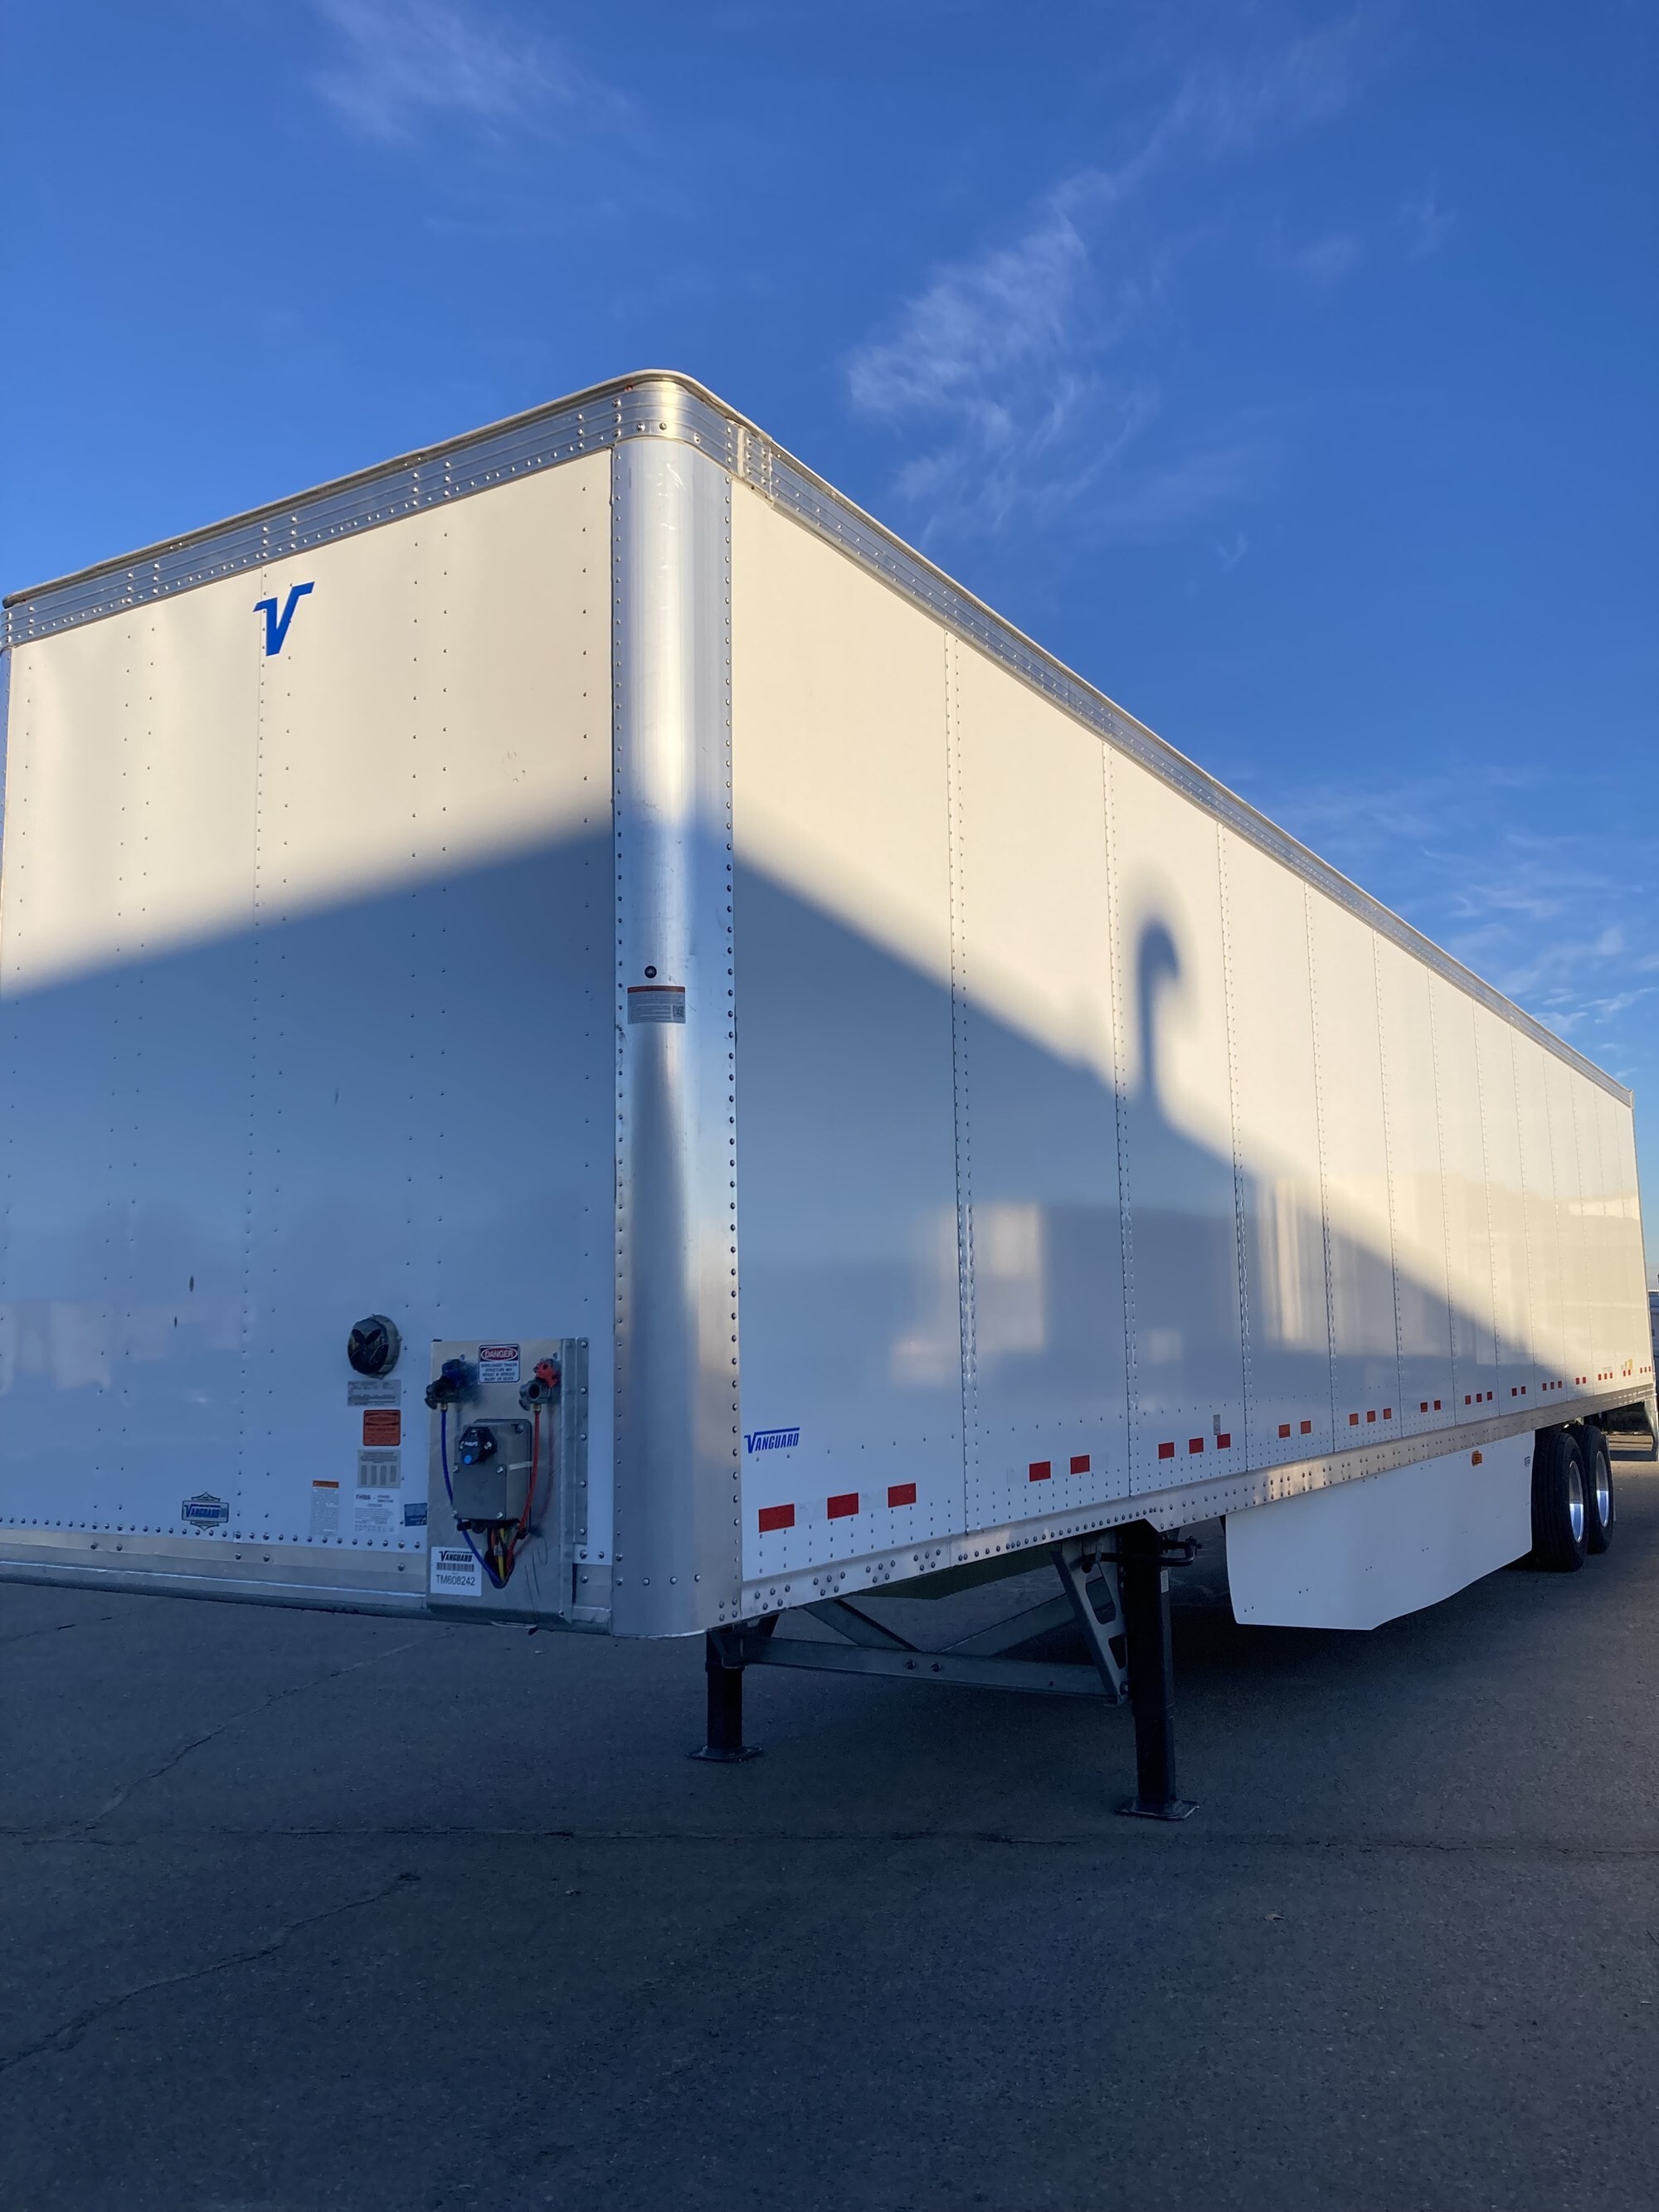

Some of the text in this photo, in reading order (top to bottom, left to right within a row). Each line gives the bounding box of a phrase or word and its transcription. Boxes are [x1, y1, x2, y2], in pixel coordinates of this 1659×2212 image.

[253, 581, 315, 657] V
[484, 1349, 513, 1359] DANGER
[743, 1427, 800, 1454] VANGUARD
[183, 1504, 221, 1519] VANGUARD
[439, 1550, 474, 1563] VANGUARD
[435, 1574, 475, 1587] TM608242
